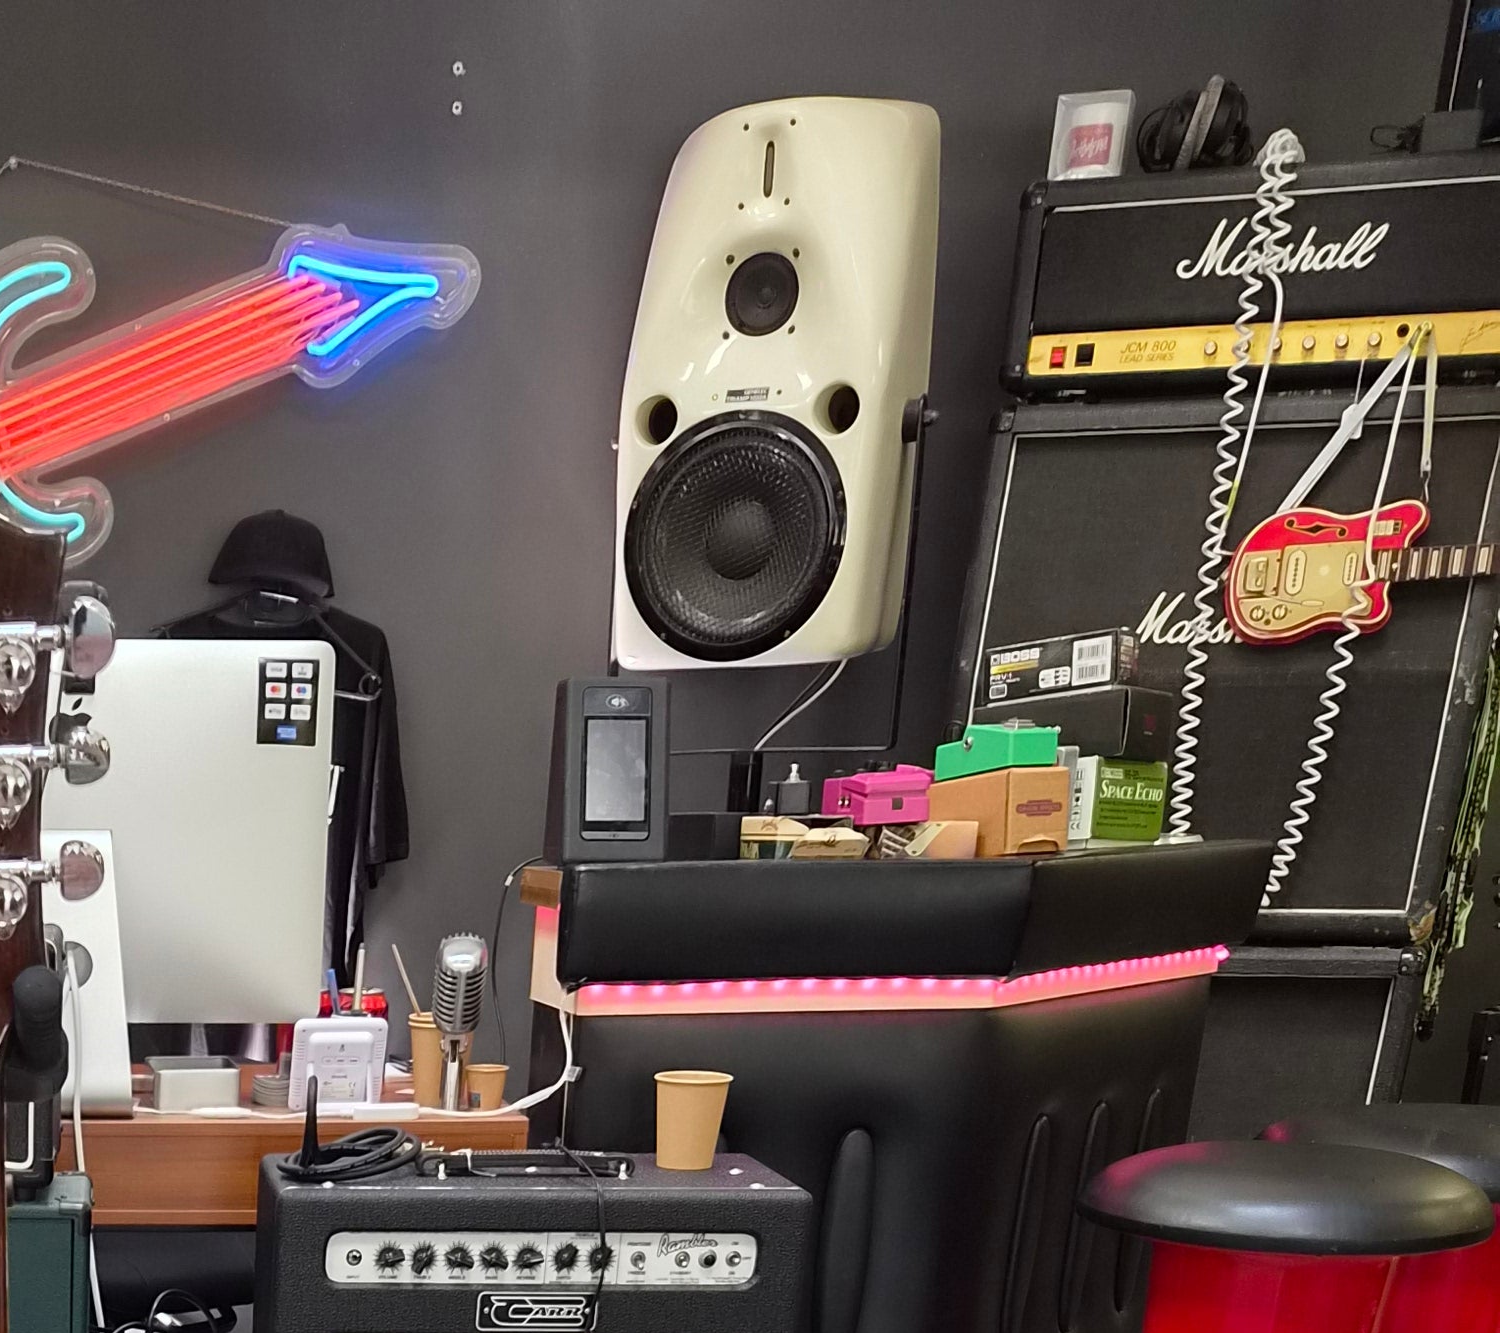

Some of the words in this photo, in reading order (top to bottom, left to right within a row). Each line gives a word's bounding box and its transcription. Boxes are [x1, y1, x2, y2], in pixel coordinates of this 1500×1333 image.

[1120, 342, 1148, 354] JCM
[1151, 340, 1177, 352] 800
[1119, 354, 1142, 364] LEAD
[1146, 352, 1174, 362] SERIES
[1100, 779, 1134, 800] SPACE
[1134, 782, 1164, 802] ECHO
